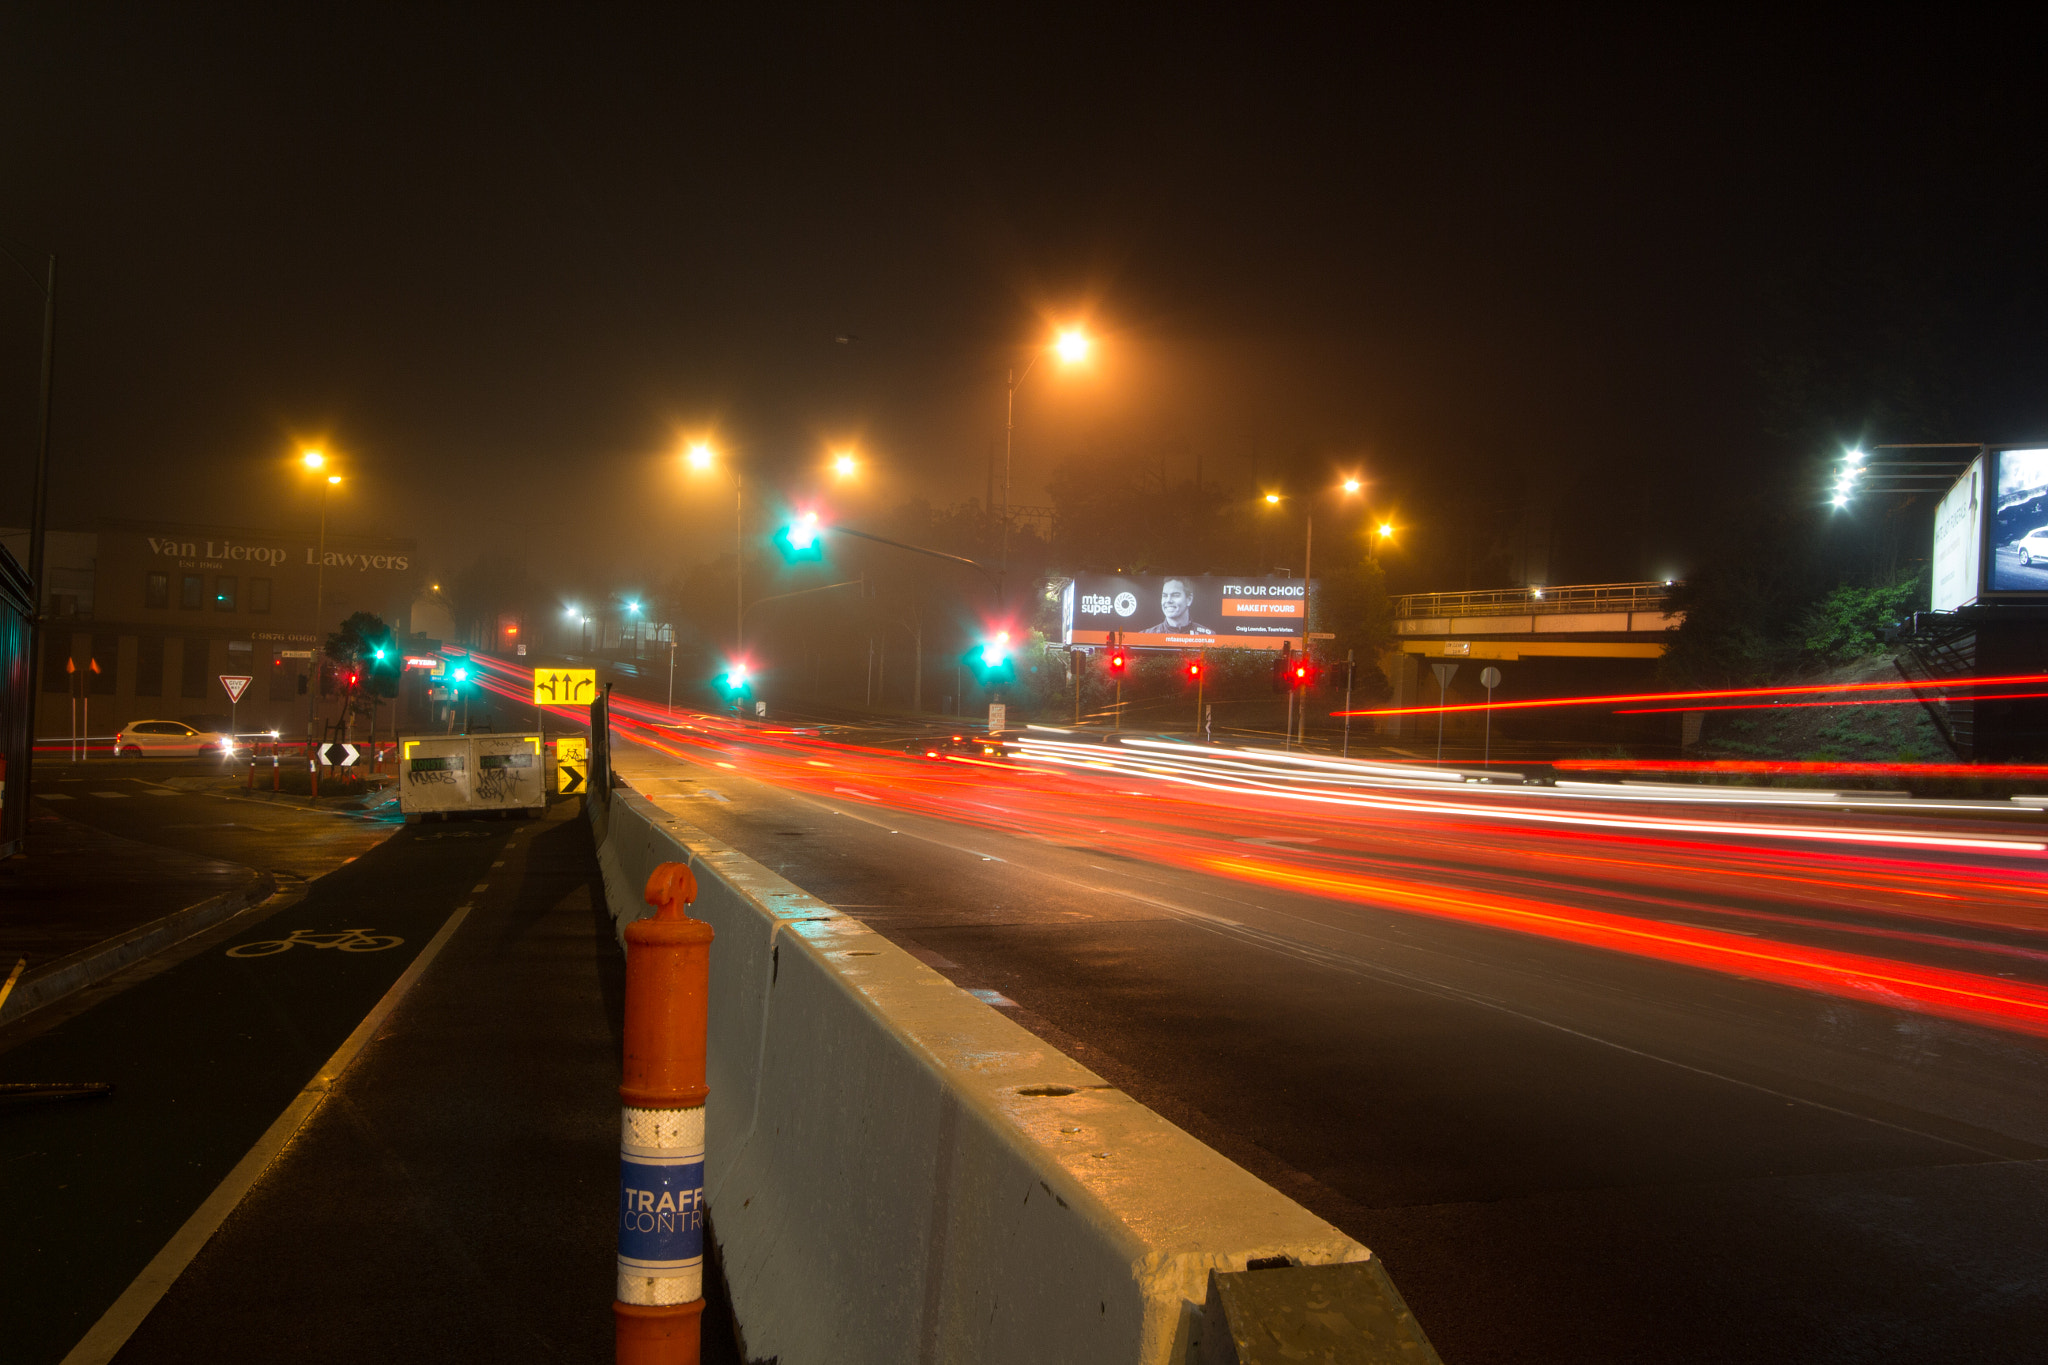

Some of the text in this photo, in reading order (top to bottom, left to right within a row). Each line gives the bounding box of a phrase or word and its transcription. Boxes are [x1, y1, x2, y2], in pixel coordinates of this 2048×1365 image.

[147, 537, 409, 572] Van Lierop Lawyers
[178, 560, 195, 568] Est
[1223, 585, 1310, 596] IT'S OUR CHOIC
[1081, 593, 1112, 606] mtaa
[1081, 603, 1113, 615] super
[1237, 604, 1259, 612] MAKE
[1269, 605, 1295, 613] YOURS
[258, 632, 316, 642] 9876 0060
[1165, 636, 1215, 644] mtaasuper.com.au
[625, 1210, 704, 1233] CONTR
